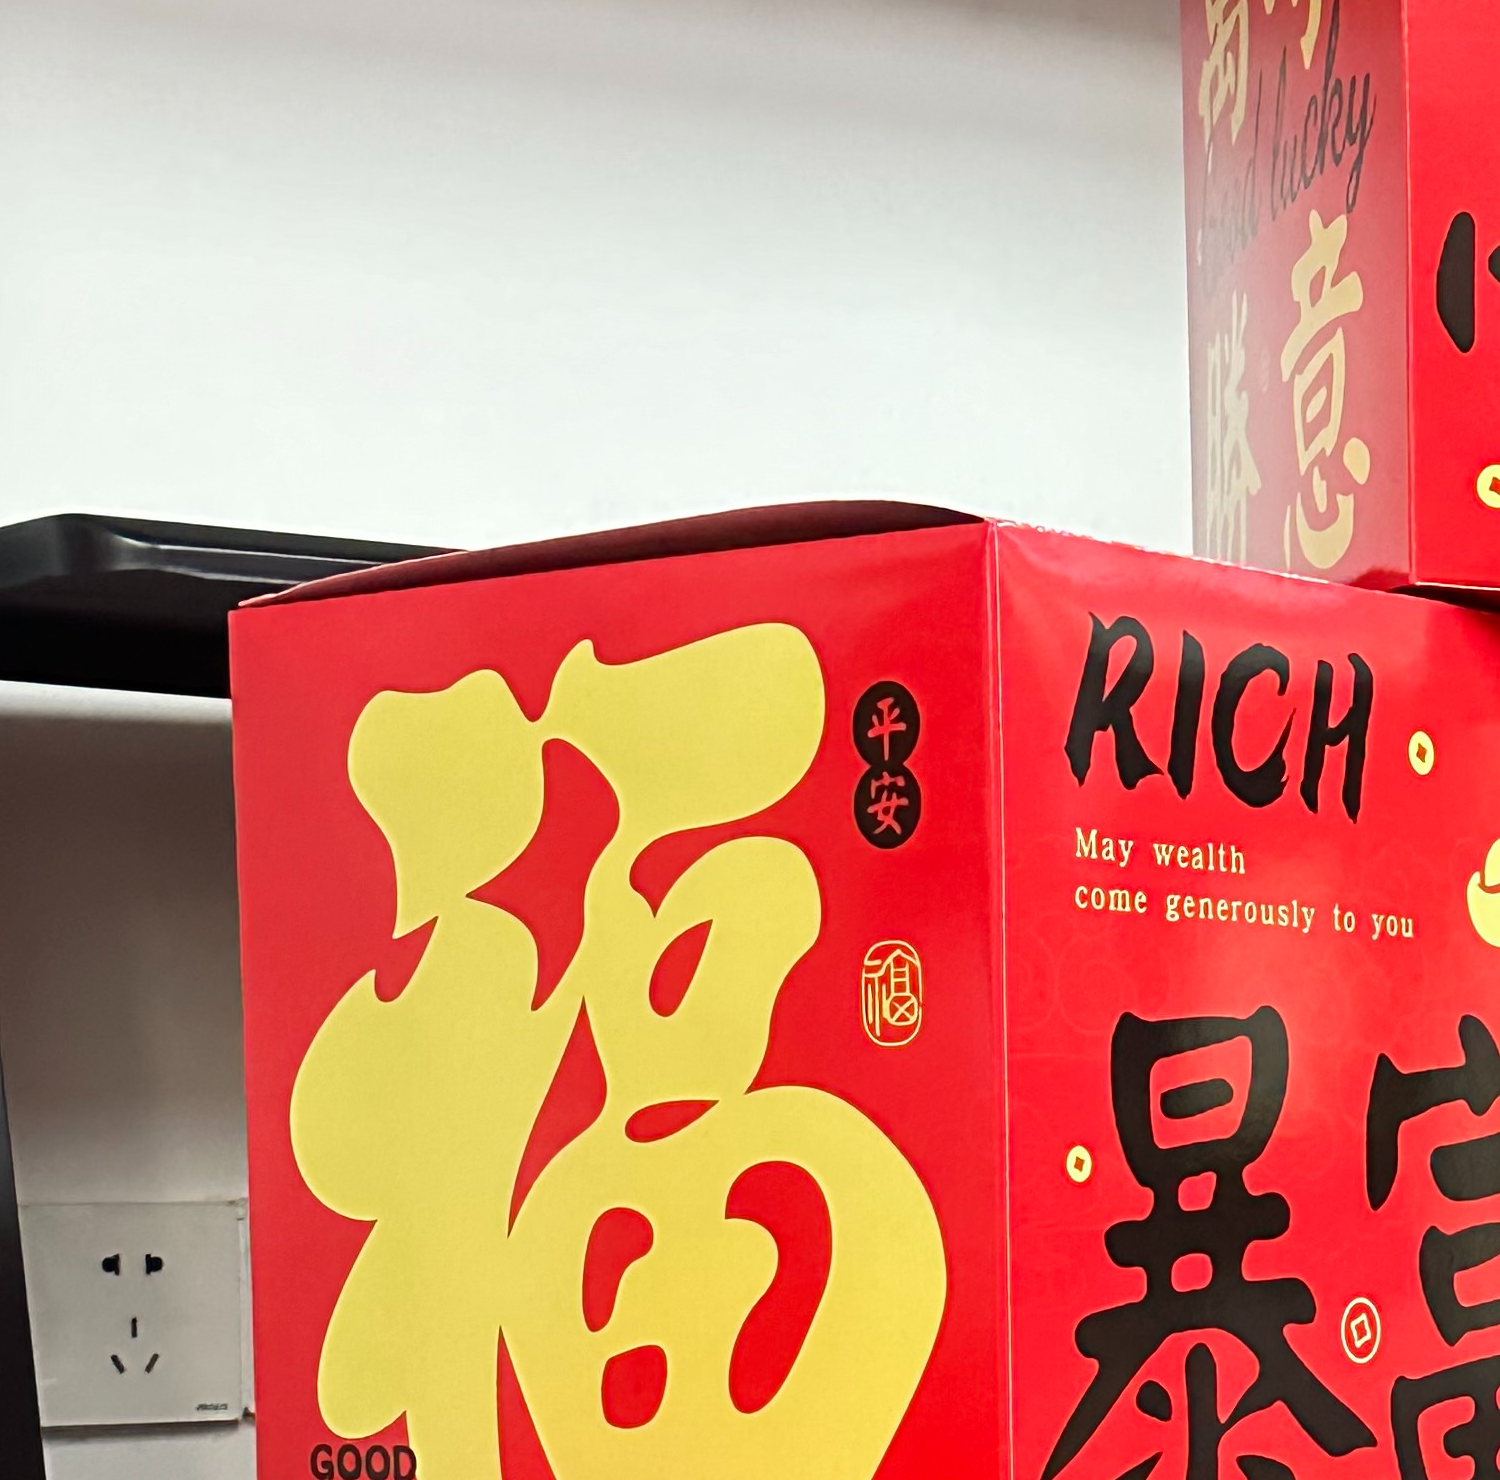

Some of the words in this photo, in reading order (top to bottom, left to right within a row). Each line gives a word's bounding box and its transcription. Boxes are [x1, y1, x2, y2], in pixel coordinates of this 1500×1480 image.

[1270, 0, 1377, 222] lucky
[862, 690, 914, 841] 平安
[1064, 611, 1374, 823] RICH
[1075, 826, 1134, 867] May
[1153, 839, 1246, 875] wealth
[1075, 883, 1147, 914] come
[1165, 893, 1316, 934] generously
[1332, 902, 1356, 933] to
[1371, 911, 1415, 941] you
